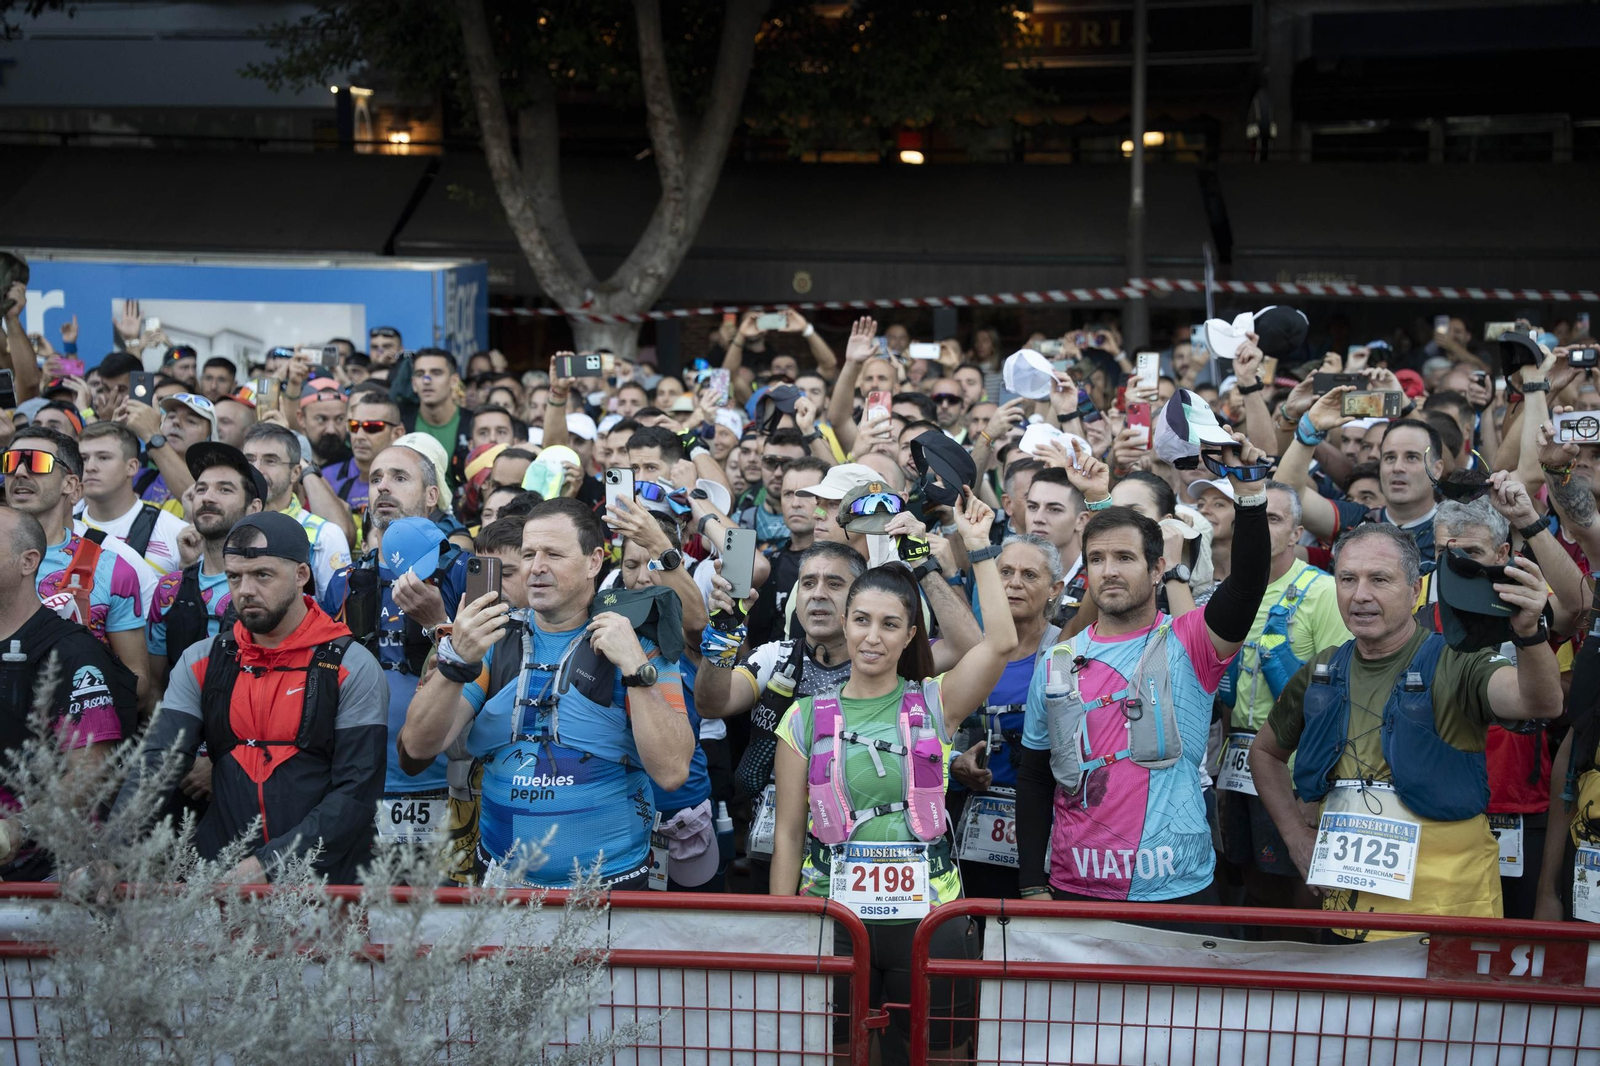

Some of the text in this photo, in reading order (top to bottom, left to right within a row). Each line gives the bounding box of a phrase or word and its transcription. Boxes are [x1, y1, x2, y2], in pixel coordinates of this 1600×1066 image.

[908, 545, 929, 556] LEKI
[575, 667, 596, 682] EVADICT
[512, 773, 574, 787] muebles
[391, 802, 430, 825] 645
[1335, 817, 1347, 827] LA
[1348, 818, 1409, 837] DESÉRTICA
[849, 847, 860, 857] LA
[988, 853, 1015, 864] asisa
[1333, 835, 1400, 869] 3125
[1071, 845, 1176, 880] VIATOR
[1342, 865, 1363, 873] MIGUEL
[851, 865, 915, 892] 2198
[1336, 874, 1368, 887] asisa
[860, 905, 891, 915] asisa
